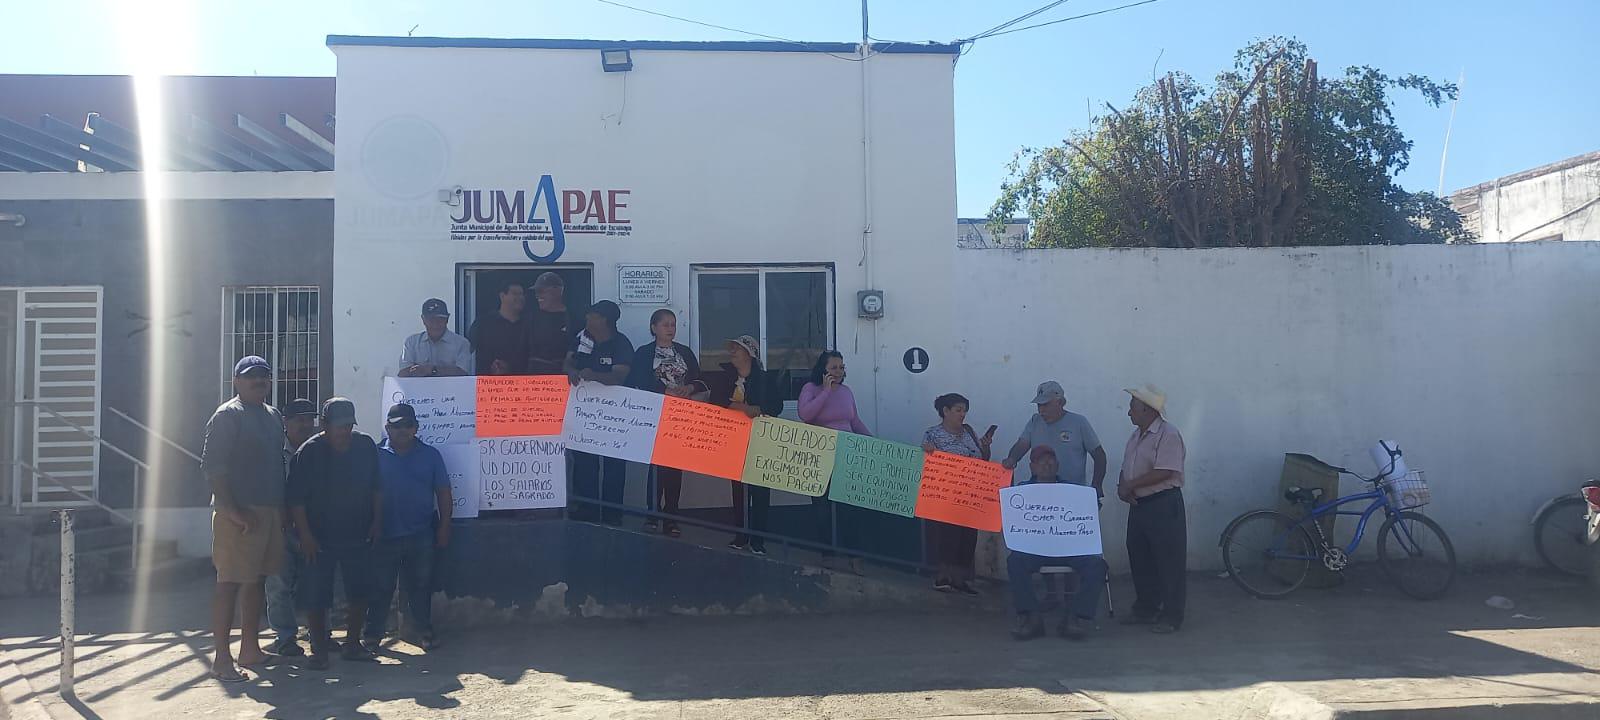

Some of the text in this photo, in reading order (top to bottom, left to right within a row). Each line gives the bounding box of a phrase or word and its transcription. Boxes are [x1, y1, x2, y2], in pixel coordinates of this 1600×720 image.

[911, 349, 922, 369] 1
[756, 420, 836, 450] JUBILADOS
[479, 439, 566, 456] SR GOBERNADOR
[776, 445, 822, 469] JUMAPAE
[846, 435, 920, 462] SRA GERENTE
[481, 460, 498, 476] UD
[531, 460, 553, 476] QUE
[755, 455, 823, 482] EXIGIMOS QUE
[846, 453, 876, 471] USTED
[484, 478, 553, 491] LOS SALARIOS
[762, 472, 825, 494] NOS PAGUEN
[484, 491, 555, 501] SON SAGRADOS
[854, 494, 866, 502] NO
[1009, 493, 1065, 512] QUEREMOS
